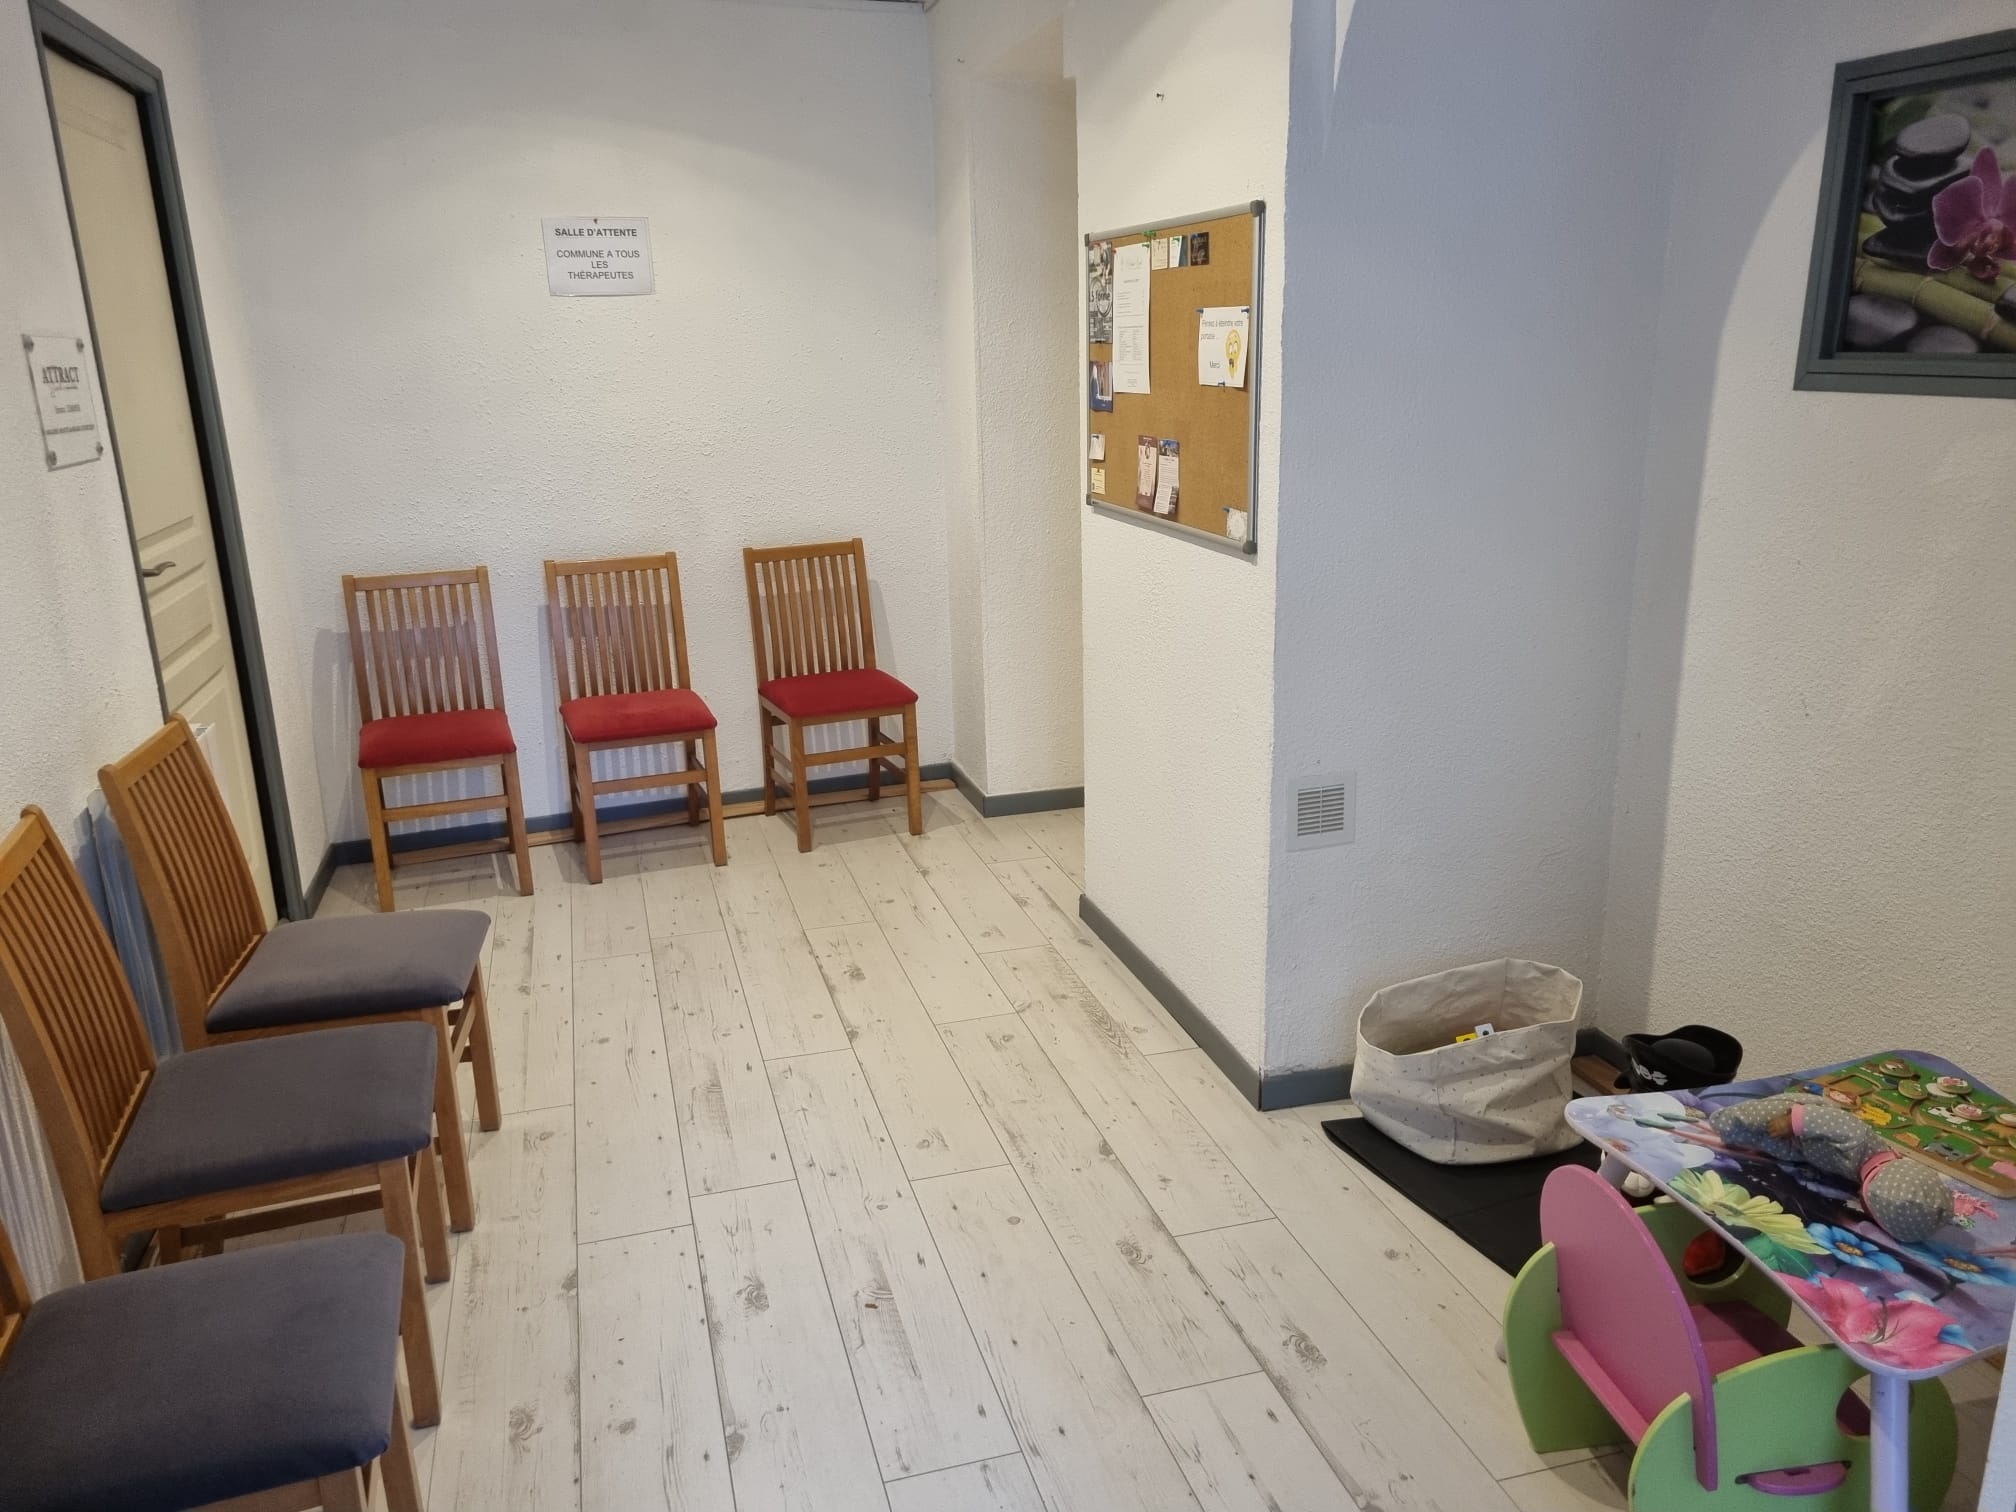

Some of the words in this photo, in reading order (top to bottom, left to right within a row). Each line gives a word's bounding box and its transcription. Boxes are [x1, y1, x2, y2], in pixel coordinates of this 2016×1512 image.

[555, 228, 585, 237] SALLE
[587, 228, 637, 237] D'ATTENTE
[557, 250, 604, 258] COMMUNE
[615, 250, 640, 258] TOUS
[591, 261, 609, 269] LES
[568, 269, 634, 280] THÉRAPEUTES
[42, 366, 80, 384] ATTRACT
